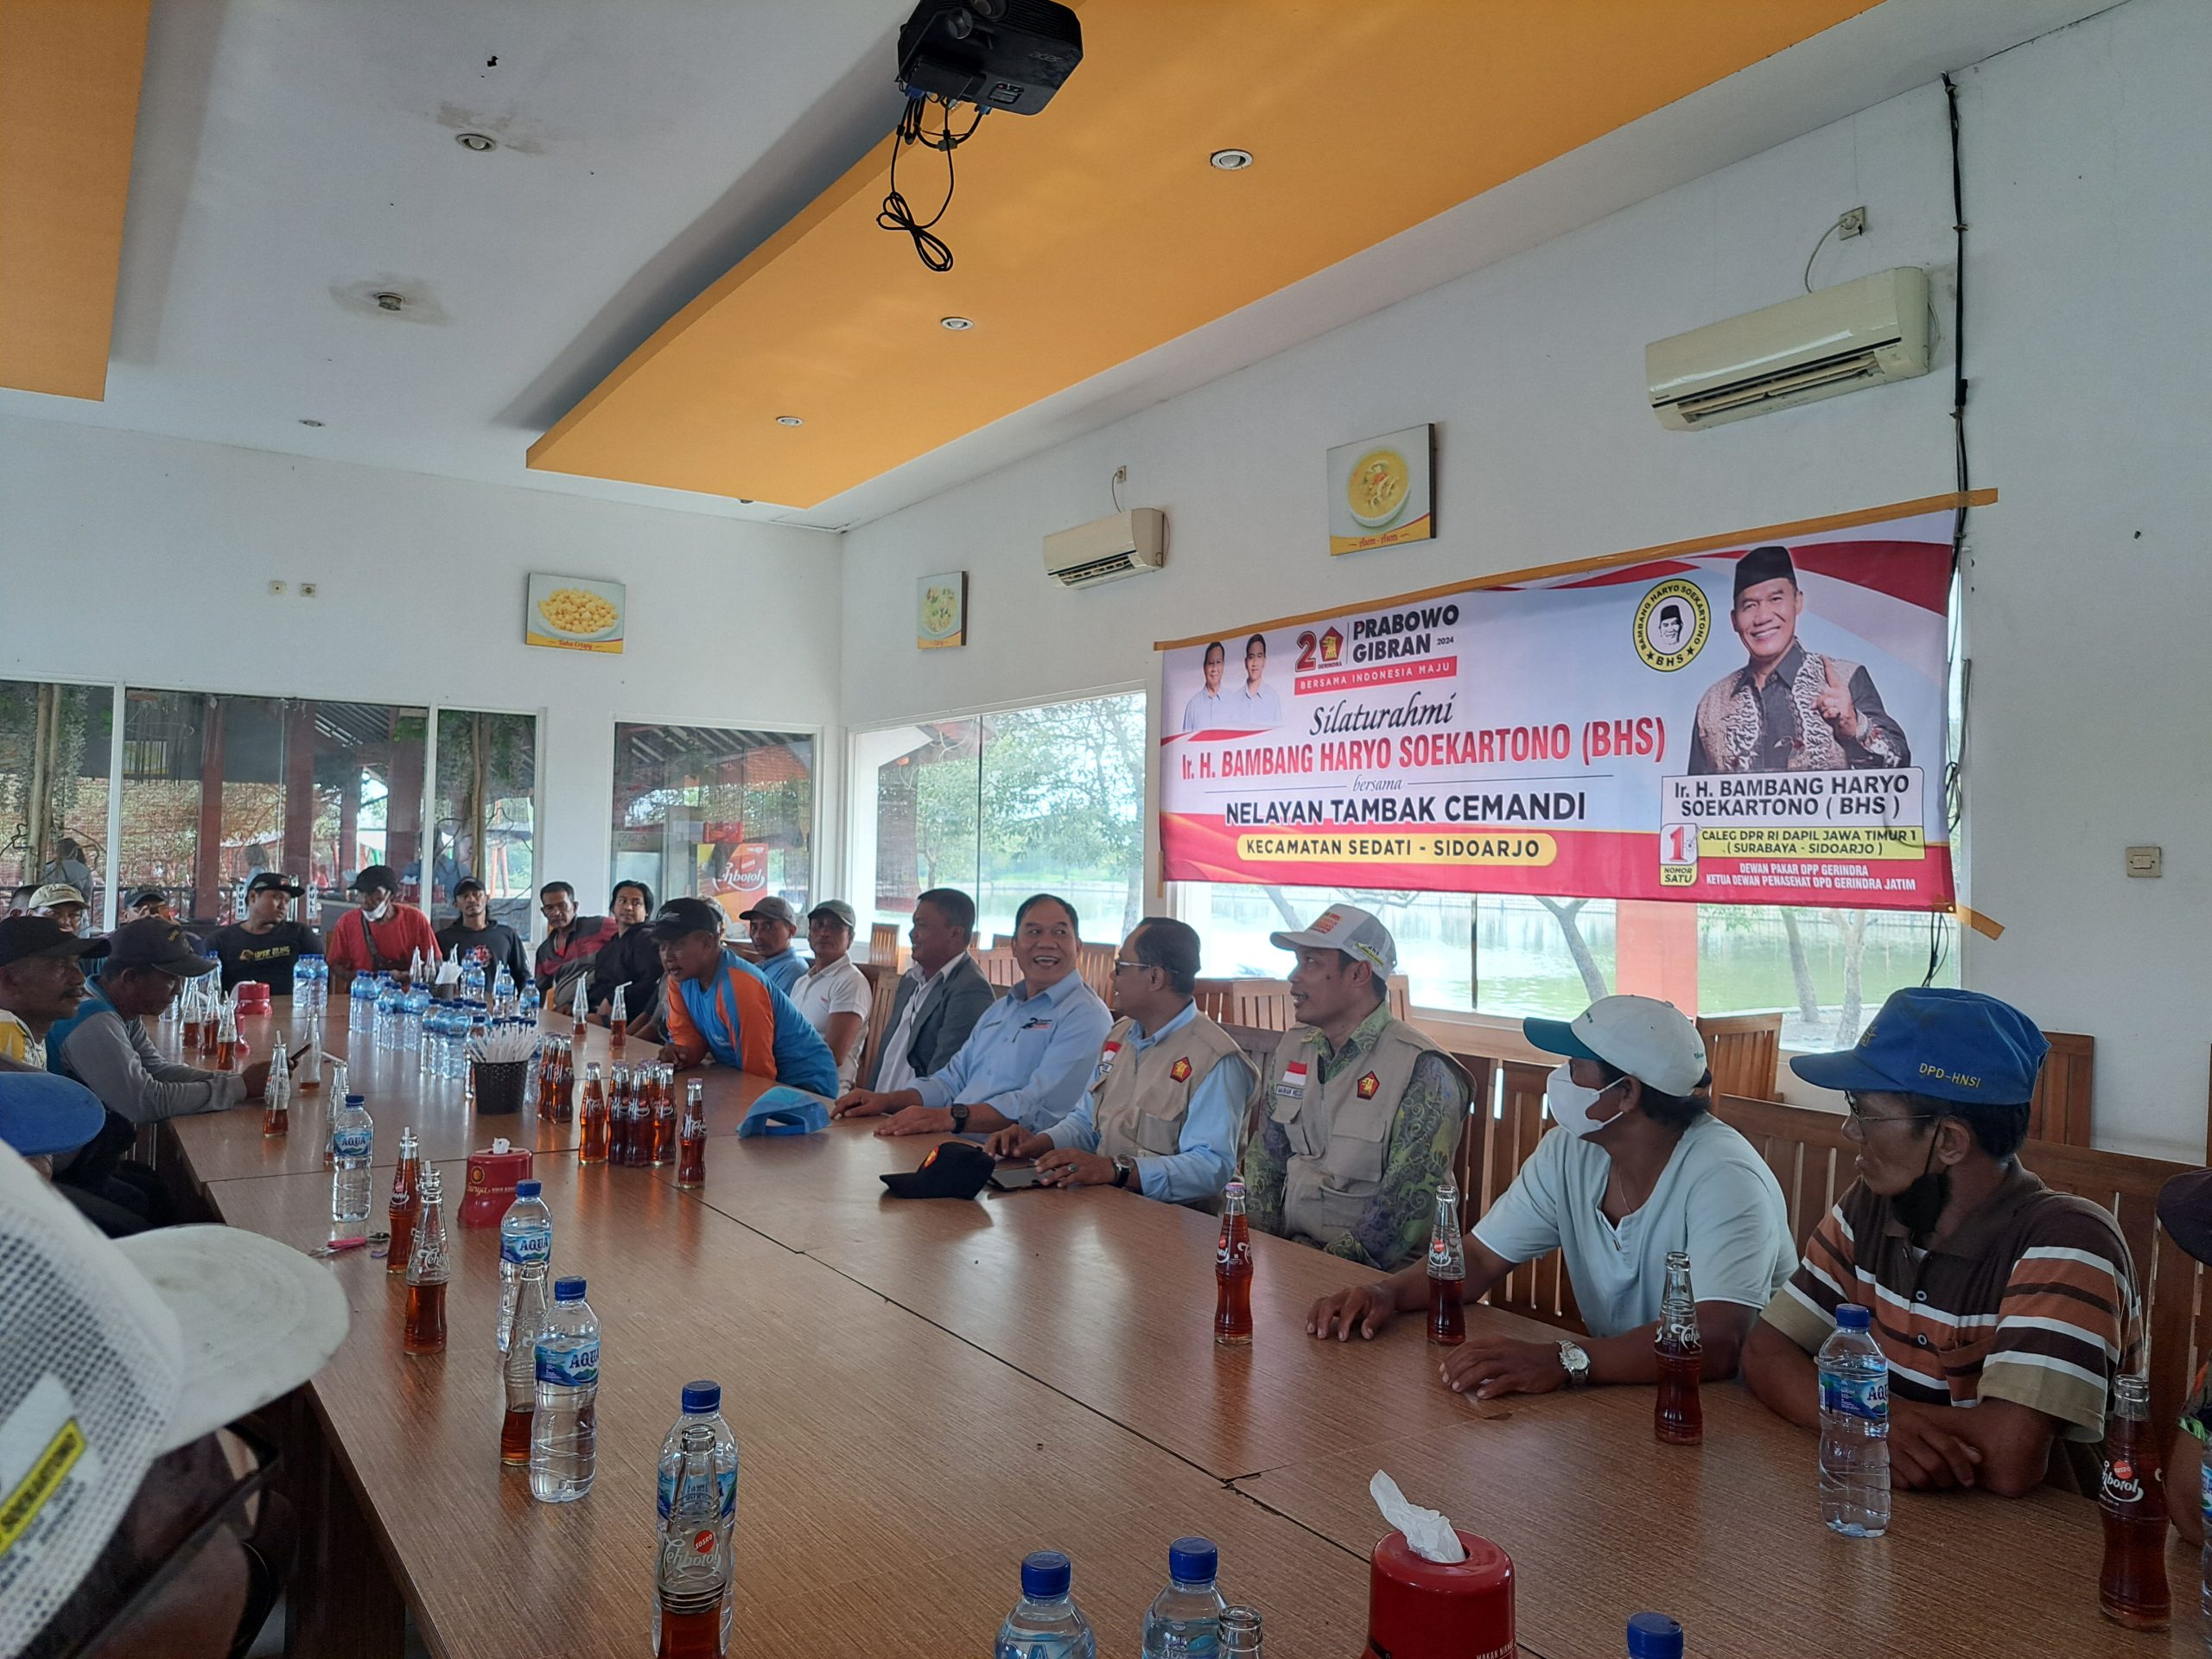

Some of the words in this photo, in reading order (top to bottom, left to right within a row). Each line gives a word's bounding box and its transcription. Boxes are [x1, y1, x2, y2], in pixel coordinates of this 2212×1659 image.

[1028, 51, 1063, 62] acer
[1650, 585, 1680, 602] HARYO
[1353, 604, 1459, 640] PRABOWO
[1352, 633, 1431, 663] GIBRAN
[1437, 636, 1454, 645] 2024
[1656, 653, 1684, 666] BHS
[1300, 677, 1347, 690] BERSAMA
[1351, 667, 1414, 683] INDONESIA
[1419, 662, 1450, 674] MAJU
[1309, 691, 1457, 735] Silaturahmi
[1182, 754, 1194, 779] Ir.
[1200, 752, 1216, 779] H.
[1222, 744, 1313, 778] BAMBANG
[1320, 737, 1391, 772] HARYO
[1399, 723, 1571, 768] SOEKARTONO
[1582, 717, 1665, 766] (BHS)
[1352, 774, 1402, 791] bersama
[1675, 782, 1690, 798] Ir.
[1696, 781, 1713, 797] H.
[1720, 777, 1823, 797] BAMBANG
[1832, 774, 1910, 795] HARYO
[1226, 800, 1323, 824] NELAYAN
[1330, 796, 1436, 823] TAMBAK
[1445, 792, 1585, 821] CEMANDI
[1681, 798, 1819, 817] SOEKARTONO
[1840, 796, 1885, 815] BHS
[621, 834, 647, 843] AQUA
[1669, 825, 1688, 862] 1
[1702, 830, 1737, 841] CALEG
[1740, 830, 1764, 841] DPR
[1768, 830, 1779, 841] RI
[1783, 830, 1820, 841] DAPIL
[1823, 830, 1861, 841] JAWA
[1865, 830, 1907, 841] TIMUR
[1910, 830, 1916, 841] 1
[1247, 839, 1341, 855] KECAMATAN
[1349, 840, 1411, 855] SEDATI
[1433, 840, 1540, 858] SIDOARJO
[1734, 842, 1797, 854] SURABAYA
[1808, 843, 1874, 854] SIDOARJO
[1739, 862, 1769, 874] DEWAN
[1771, 863, 1799, 874] PAKAR
[1821, 864, 1869, 876] GERINDRA
[1664, 874, 1693, 883] SATU
[1707, 874, 1731, 885] KETUA
[1732, 874, 1760, 887] DEWAN
[1762, 875, 1812, 887] PENASEHAT
[1834, 878, 1882, 890] GERINDRA
[1884, 879, 1916, 890] JATIM
[1919, 1062, 1981, 1089] DPD-HNSI
[341, 1136, 366, 1147] AQUA
[519, 1236, 549, 1253] AQUA
[695, 1534, 714, 1550] SOSRO
